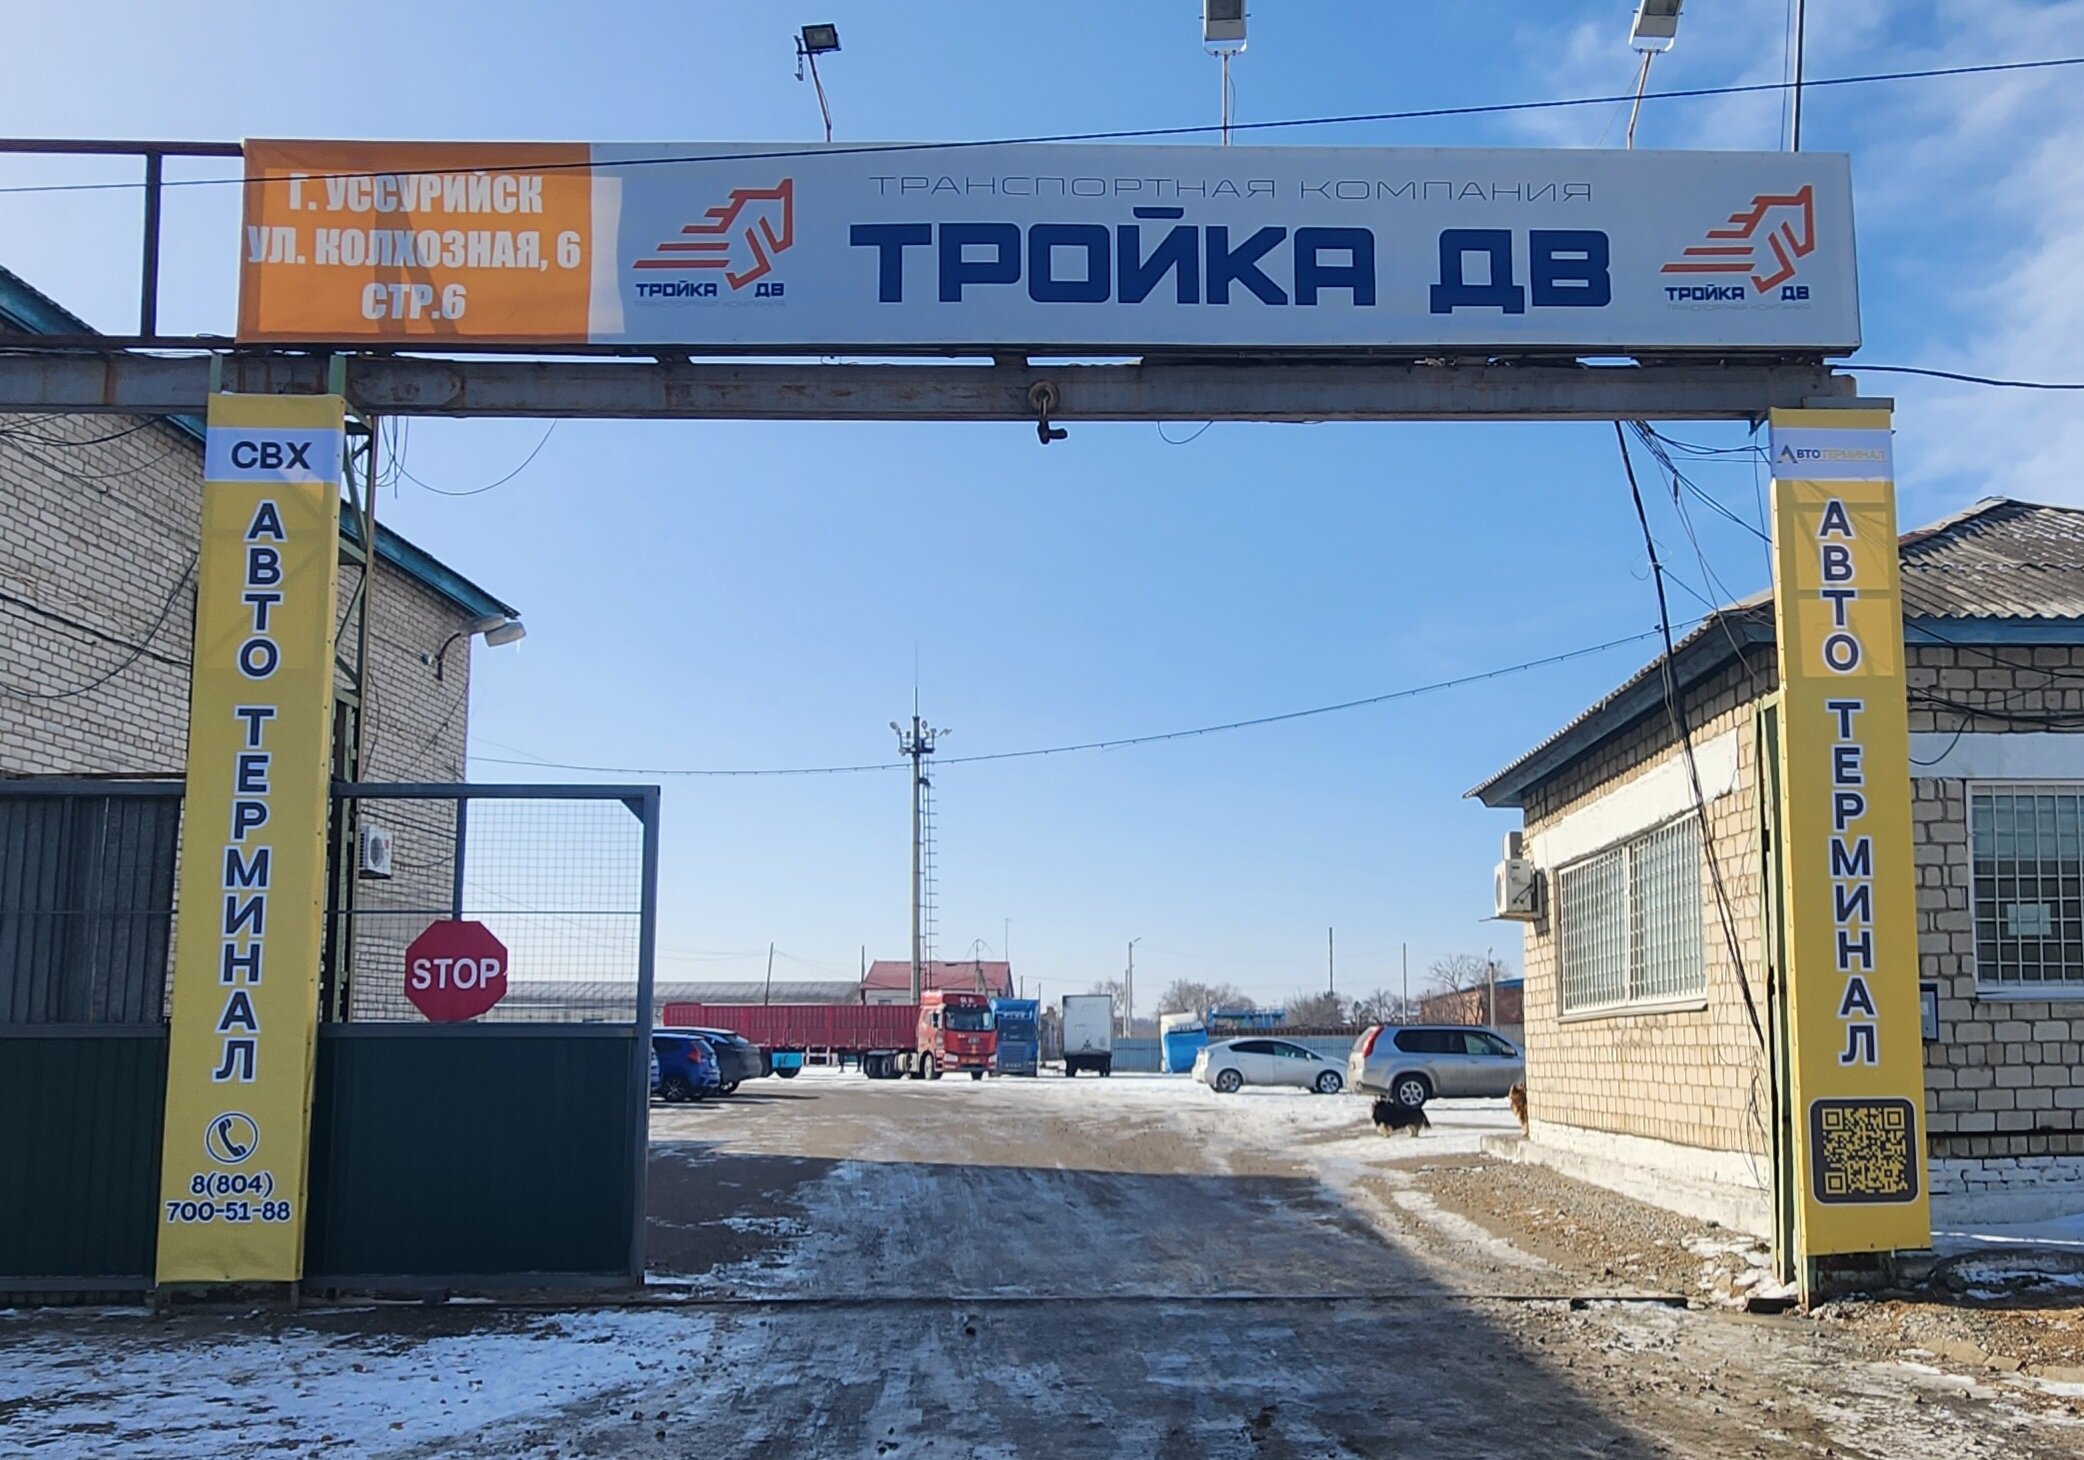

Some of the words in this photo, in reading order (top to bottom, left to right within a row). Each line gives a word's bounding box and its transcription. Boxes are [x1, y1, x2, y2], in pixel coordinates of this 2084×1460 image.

[288, 172, 317, 211] Г.
[326, 171, 543, 214] УССУРИЙСК
[869, 176, 1276, 199] ТРАНСПОРТНАЯ
[1301, 179, 1592, 202] КОМПАНИЯ
[247, 225, 306, 264] УЛ.
[315, 227, 548, 272] КОЛХОЗНАЯ,
[557, 235, 582, 267] 6
[849, 206, 1377, 307] ТРОЙКА
[1430, 228, 1612, 314] ДВ
[361, 282, 467, 320] СТР.6
[635, 280, 718, 297] ТРОЙКА
[754, 282, 785, 298] ДВ
[1664, 284, 1745, 301] ТРОЙКА
[1780, 285, 1810, 301] ДВ
[231, 441, 312, 470] СВХ
[238, 501, 286, 679] АВТО
[1819, 499, 1861, 673] АВТО
[212, 705, 277, 1083] ТЕРМИНАЛ
[1826, 699, 1879, 1066] ТЕРМИНАЛ
[412, 957, 501, 990] STOP
[190, 1171, 274, 1199] 8(804)
[166, 1201, 291, 1222] 700-51-88
